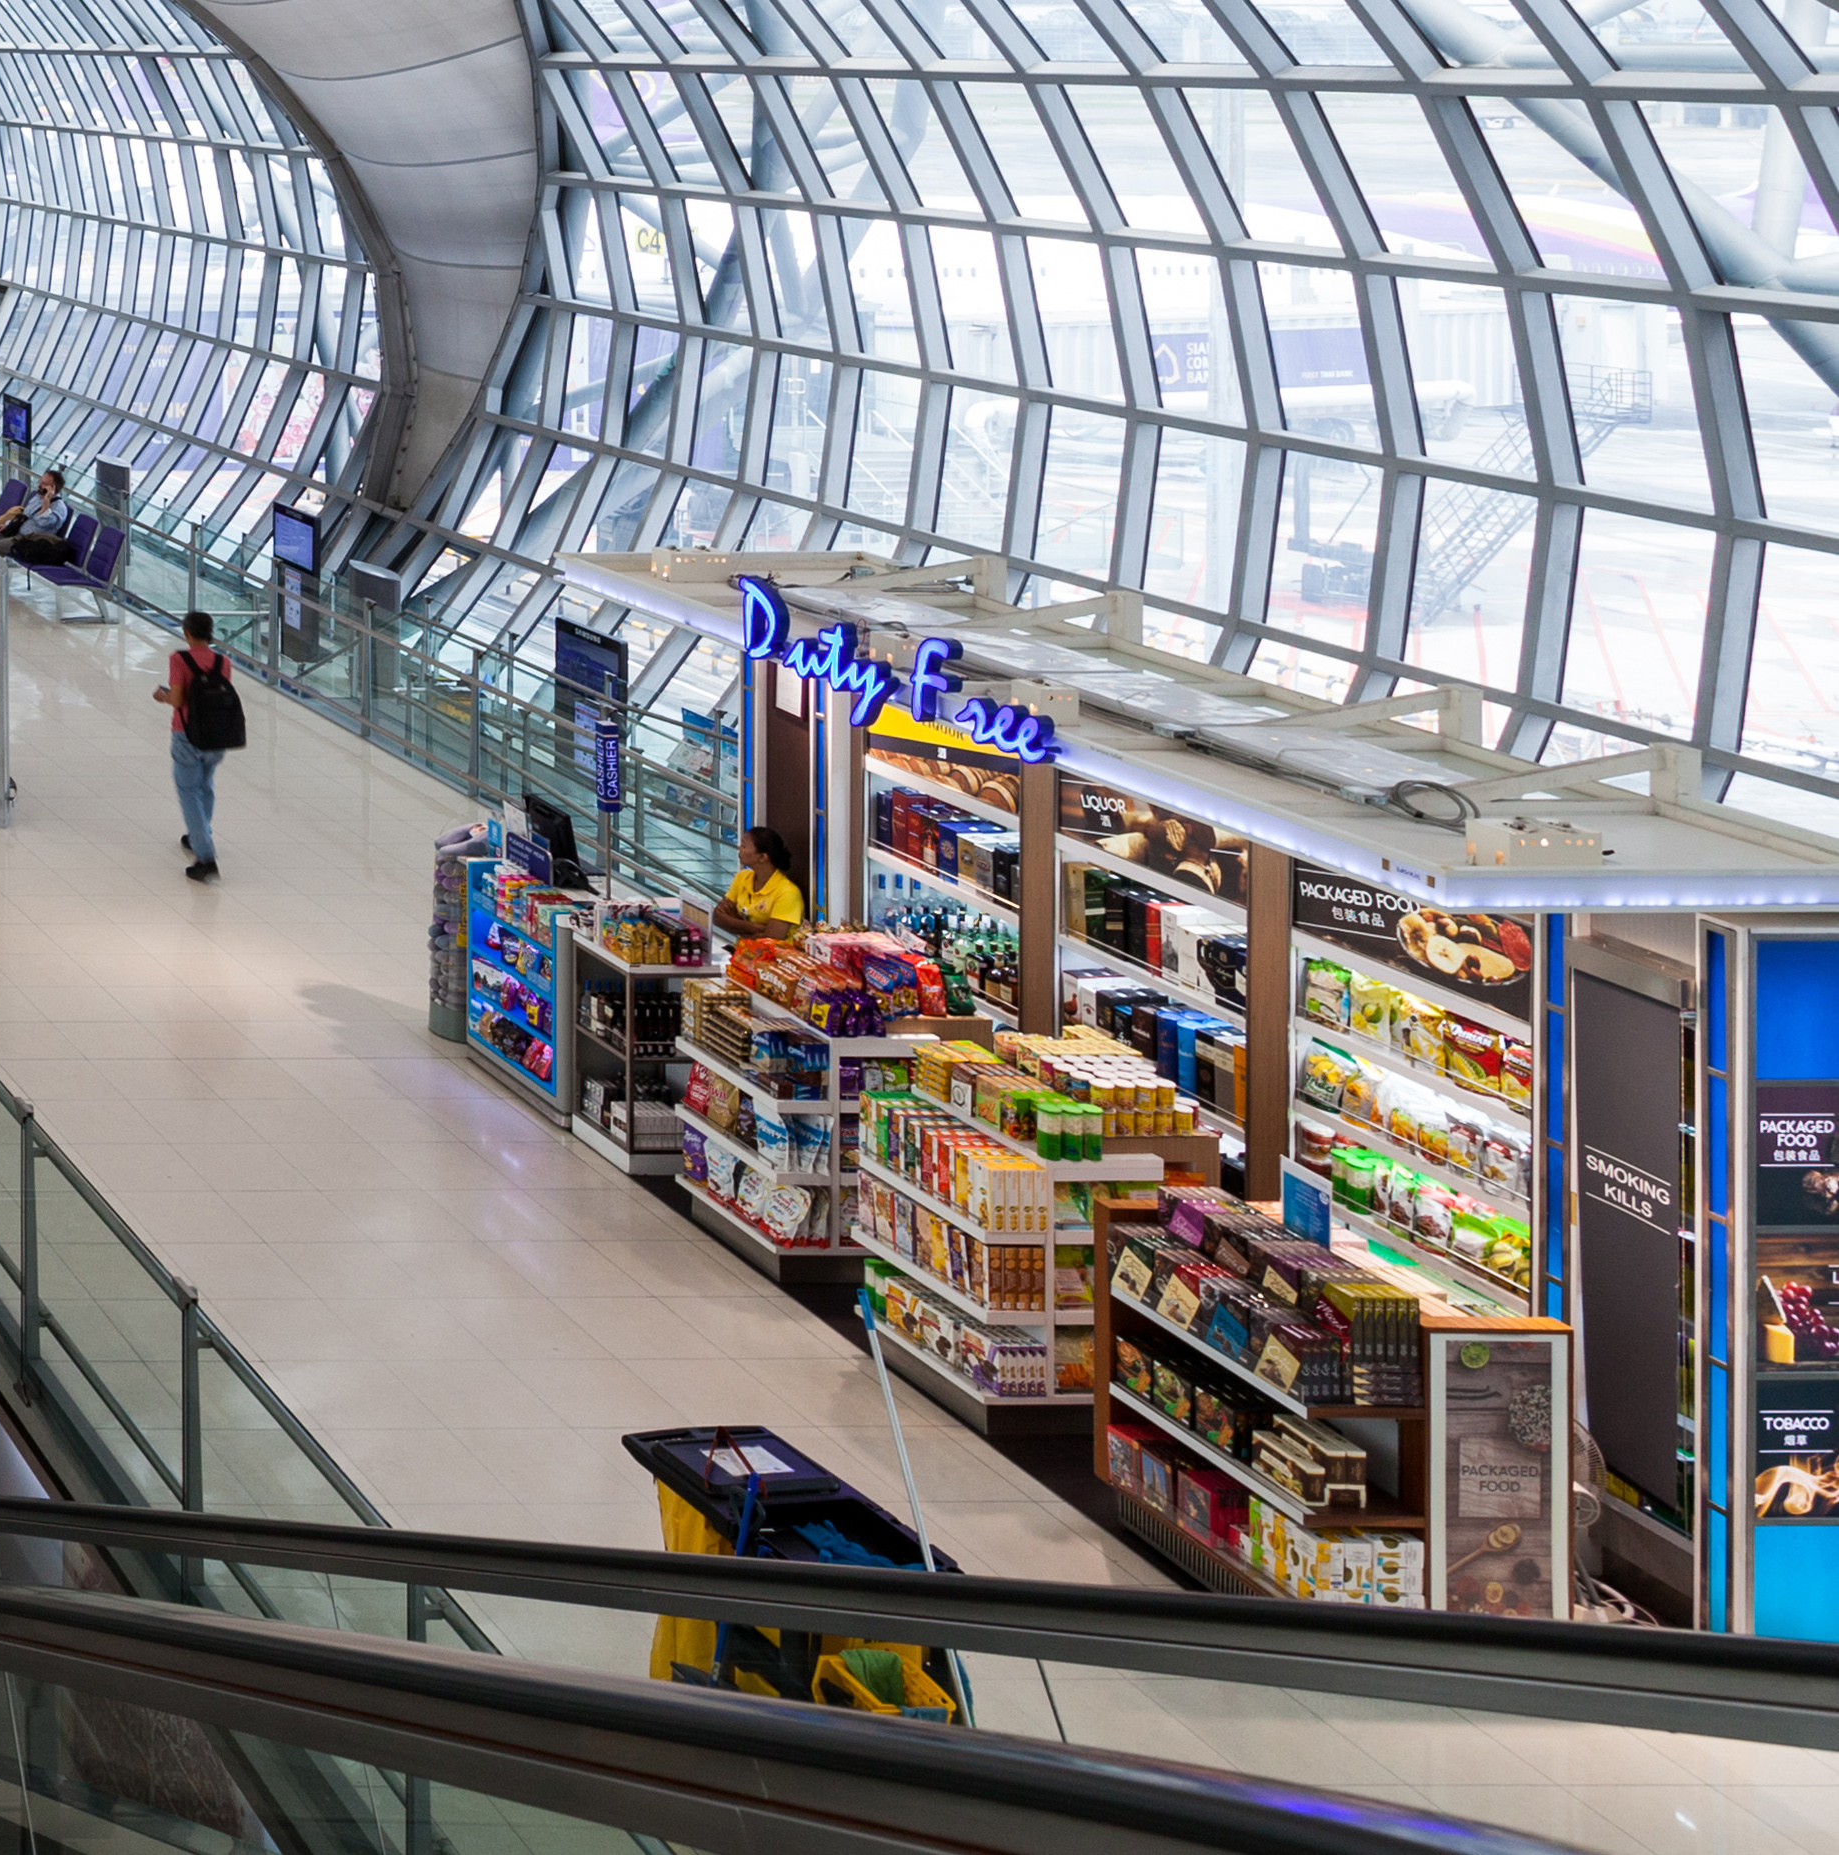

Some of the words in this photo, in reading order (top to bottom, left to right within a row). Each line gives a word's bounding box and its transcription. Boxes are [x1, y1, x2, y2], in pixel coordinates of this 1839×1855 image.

[637, 228, 661, 253] C4
[574, 627, 601, 644] SAMSUNG
[739, 575, 891, 726] Duty
[911, 637, 1049, 763] Free
[596, 737, 605, 796] CASHIER
[607, 739, 618, 798] CASHIER
[1080, 794, 1127, 814] LIQUOR
[1299, 881, 1373, 907] PACKAGED
[1375, 895, 1421, 914] FOOD
[1331, 906, 1385, 928] 包装食品
[1759, 1121, 1835, 1133] PACKAGED
[1777, 1134, 1817, 1147] FOOD
[1773, 1149, 1821, 1162] 包装食品
[1585, 1154, 1671, 1206] SMOKING
[1604, 1182, 1653, 1218] KILLS
[1763, 1417, 1830, 1431] TOBACCO
[1461, 1465, 1539, 1478] PACKAGED
[1479, 1481, 1521, 1493] FOOD
